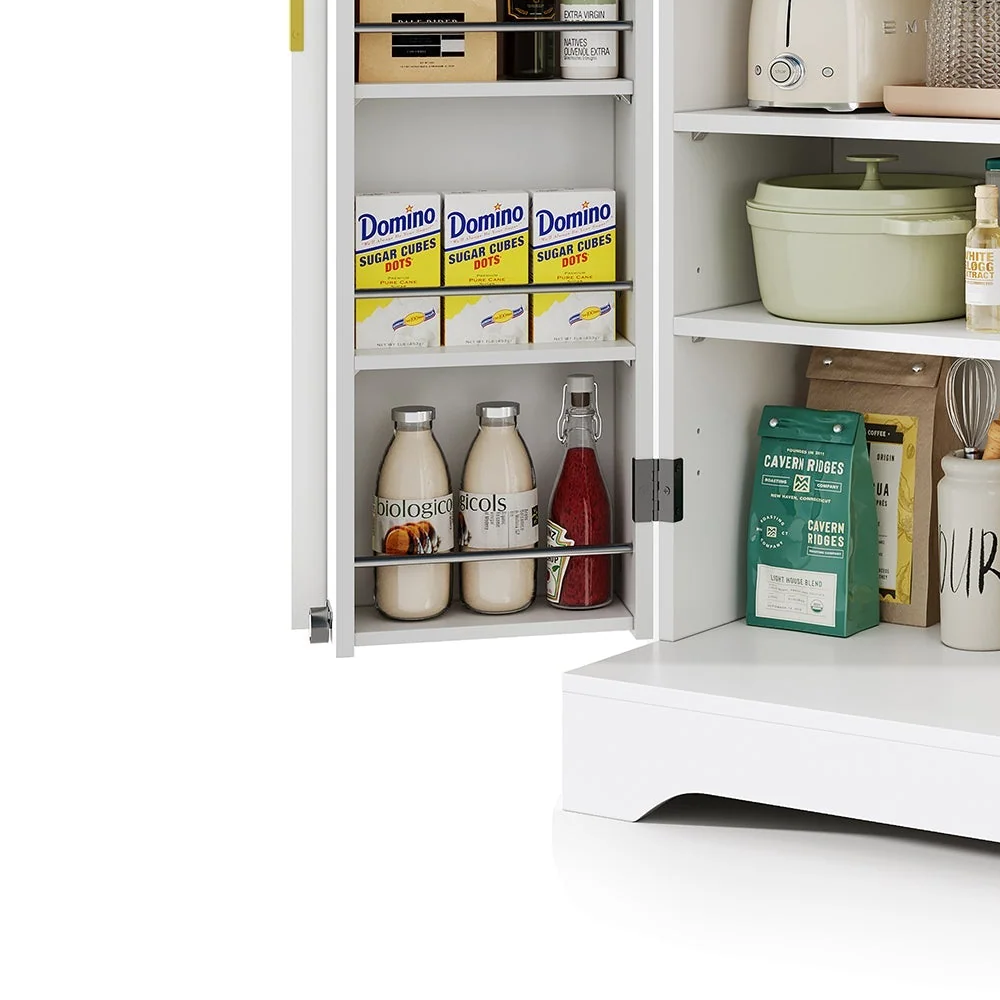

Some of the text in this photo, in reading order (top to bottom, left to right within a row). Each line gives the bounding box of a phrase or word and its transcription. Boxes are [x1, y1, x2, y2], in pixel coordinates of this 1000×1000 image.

[564, 10, 605, 19] EXTRA VIRGIN
[564, 38, 587, 47] NATIVES
[591, 47, 610, 55] EXTRA
[358, 208, 435, 240] Domino
[447, 206, 524, 238] Domino
[536, 204, 611, 236] Domino
[360, 238, 436, 267] SUGAR CUBES
[448, 236, 524, 265] SUGAR CUBES
[537, 234, 611, 262] SUGAR CUBES
[385, 257, 412, 272] DOTS
[474, 255, 500, 270] DOTS
[562, 252, 588, 267] DOTS
[867, 429, 886, 437] COFFEE
[877, 453, 894, 461] ORIGIN
[764, 455, 844, 475] CAVERN RIDGES
[873, 482, 889, 496] UA
[800, 496, 831, 504] CONNECTICUT
[760, 515, 785, 526] ROASTING
[807, 519, 844, 534] CAVERN
[760, 538, 783, 548] COMPANY
[807, 533, 844, 547] RIDGES
[770, 574, 784, 582] LIGHT
[786, 577, 804, 585] HOUSE
